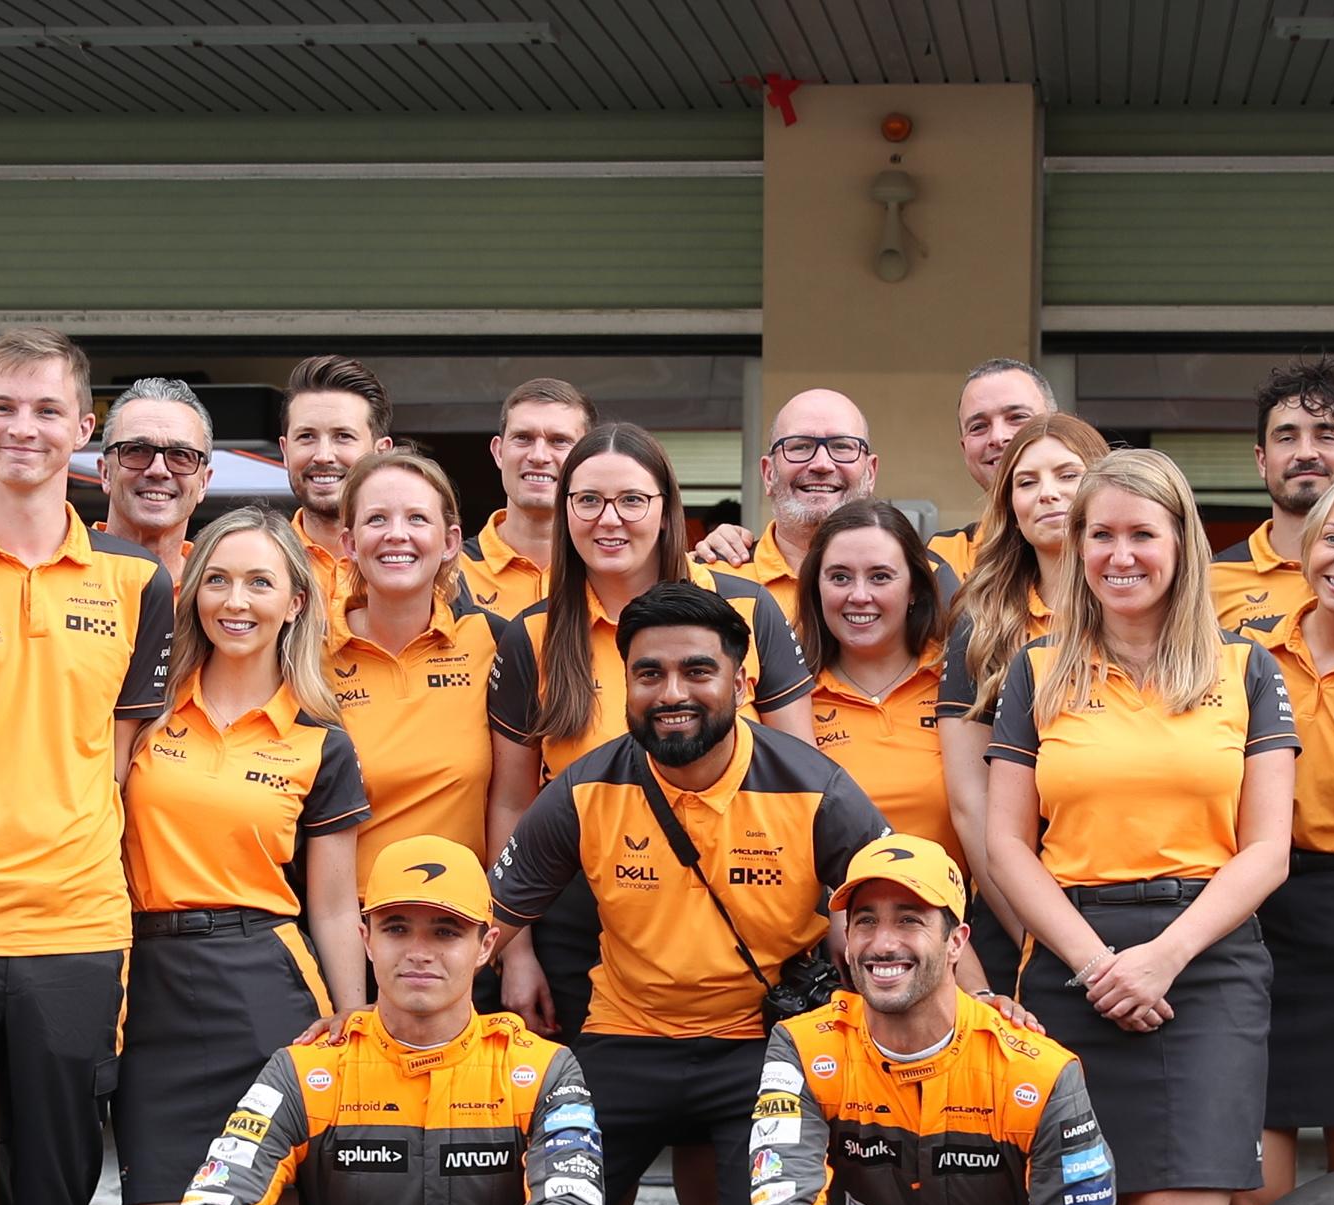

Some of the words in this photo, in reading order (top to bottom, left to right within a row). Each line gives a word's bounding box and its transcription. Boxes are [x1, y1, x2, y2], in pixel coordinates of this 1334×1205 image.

[67, 596, 117, 607] McLaren
[66, 614, 116, 637] OKX
[426, 653, 469, 664] McLaren
[427, 673, 471, 687] OKX
[816, 730, 850, 746] DELL
[153, 744, 187, 759] DELL
[729, 847, 783, 858] McLaren
[616, 865, 659, 880] DELL
[729, 868, 782, 885] OKX
[616, 881, 659, 890] Technologies
[410, 1055, 441, 1069] Hilton
[813, 1062, 836, 1071] Gulf
[308, 1076, 331, 1084] Gulf
[1015, 1089, 1037, 1101] Gulf
[339, 1100, 380, 1112] android
[449, 1098, 504, 1109] McLaren
[228, 1115, 267, 1136] WALT
